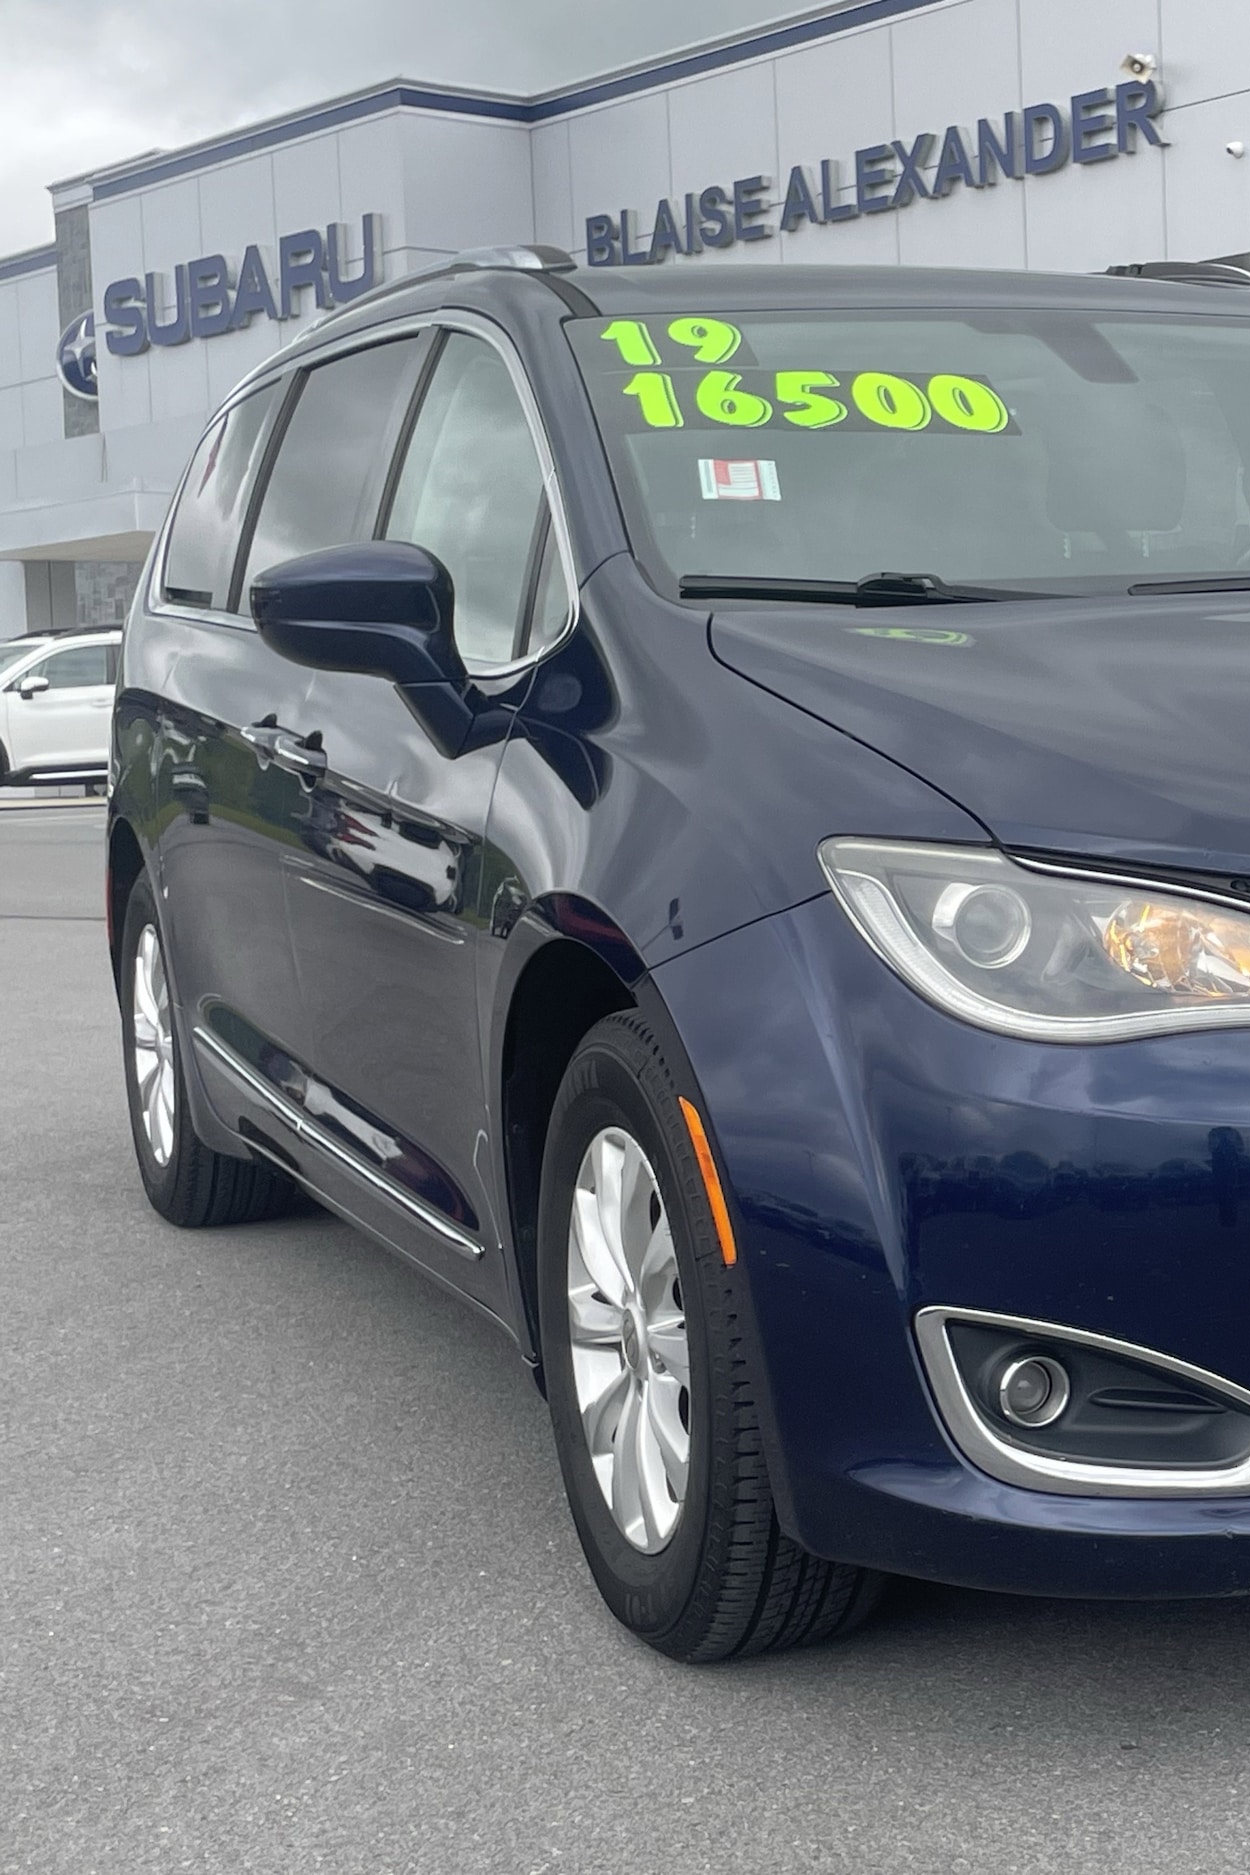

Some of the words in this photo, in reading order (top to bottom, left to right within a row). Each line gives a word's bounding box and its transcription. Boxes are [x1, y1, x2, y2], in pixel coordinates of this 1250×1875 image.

[586, 175, 771, 266] BLAISE
[780, 79, 1170, 232] ALEXANDER
[104, 212, 382, 357] SUBARU
[601, 317, 741, 365] 19
[623, 371, 1008, 432] 16500
